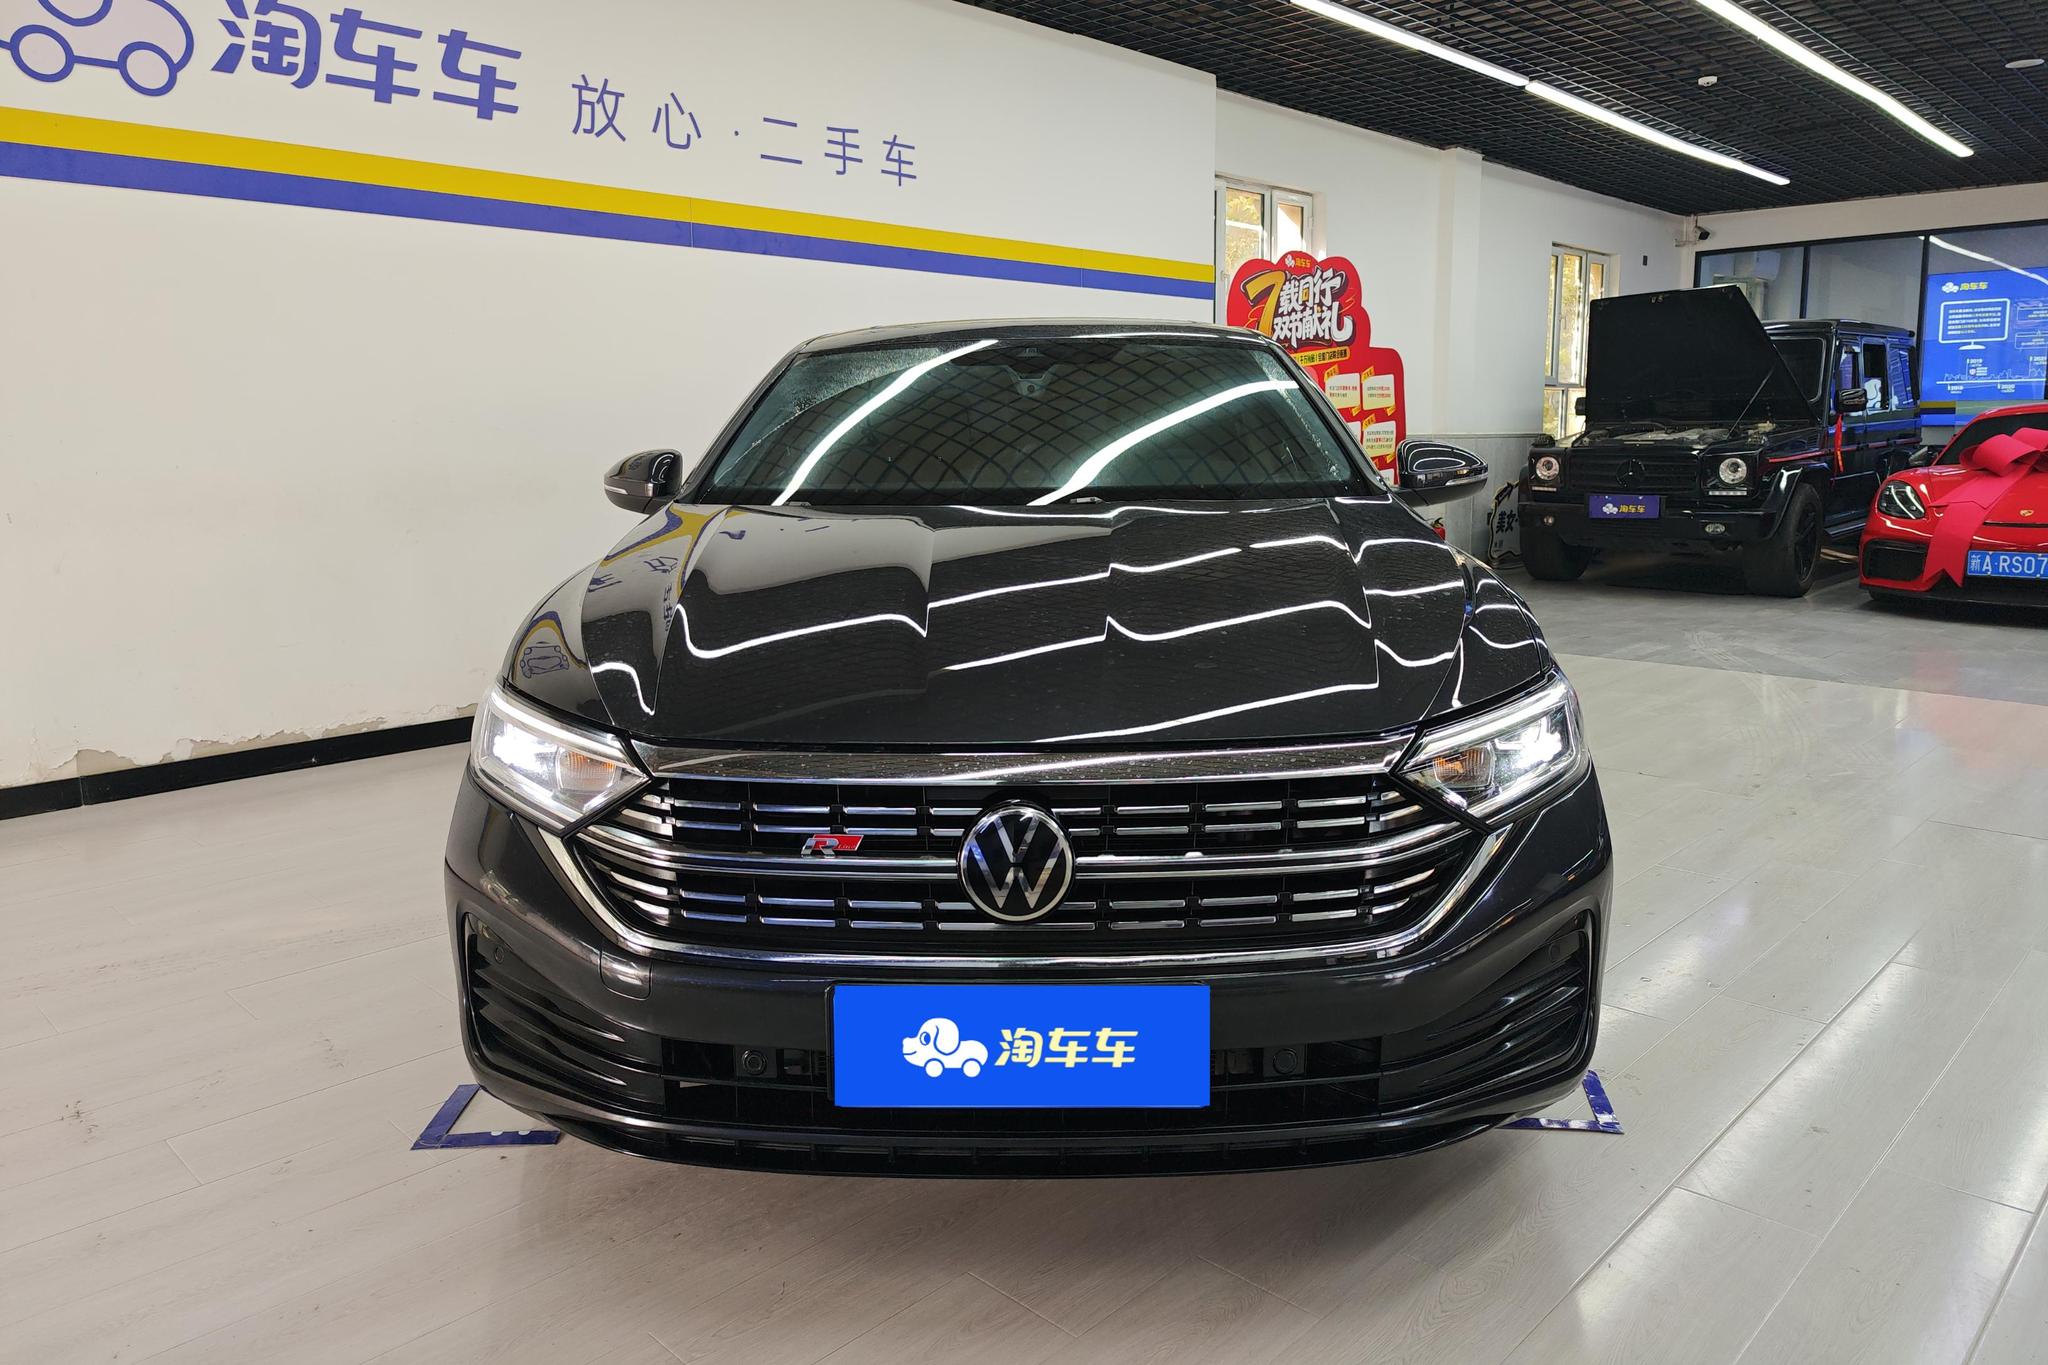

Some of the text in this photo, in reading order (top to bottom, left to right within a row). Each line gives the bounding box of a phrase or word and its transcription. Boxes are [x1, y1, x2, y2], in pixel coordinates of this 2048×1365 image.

[211, 0, 522, 121] 淘车车
[1271, 301, 1353, 348] 双节献礼
